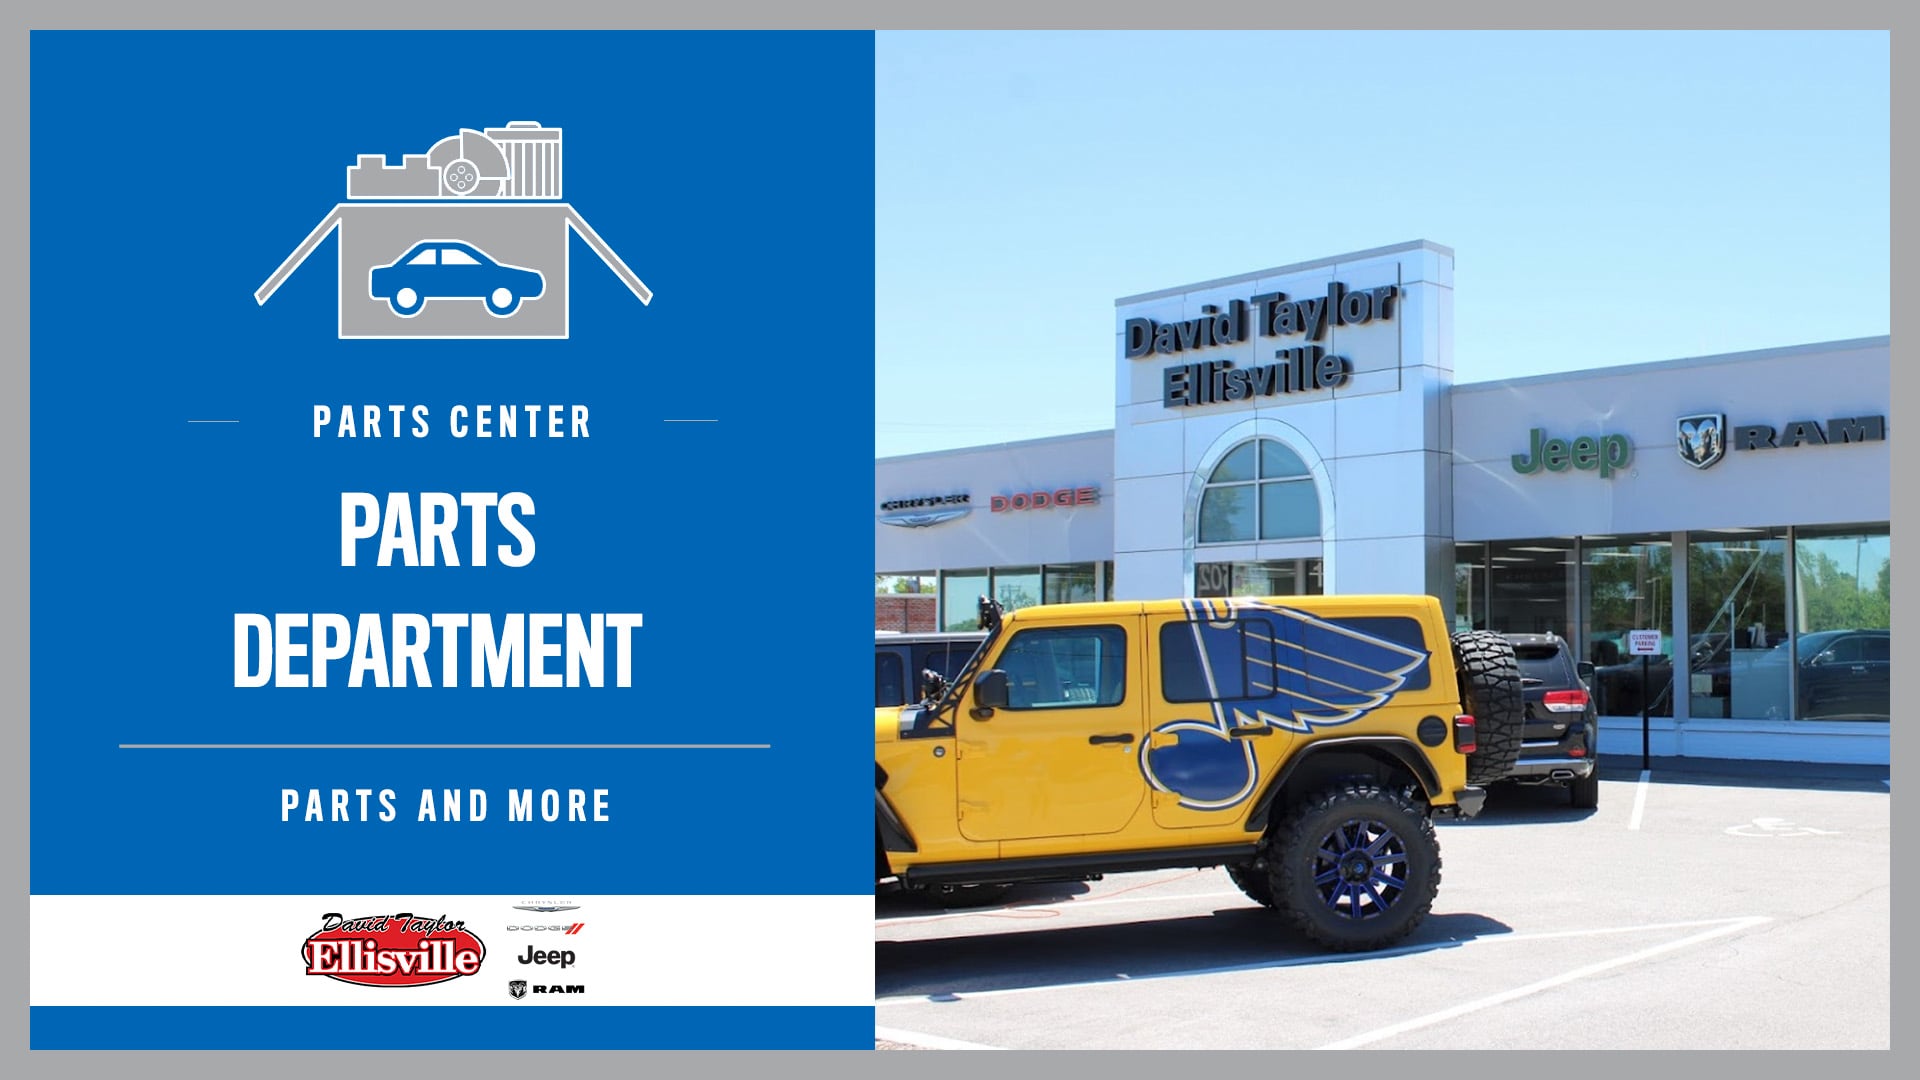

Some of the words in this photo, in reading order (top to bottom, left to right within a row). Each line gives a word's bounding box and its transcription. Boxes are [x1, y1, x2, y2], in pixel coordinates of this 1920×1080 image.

[1125, 299, 1245, 359] David
[1250, 281, 1396, 341] Taylor
[1163, 345, 1350, 408] Ellisville
[1511, 427, 1630, 479] Jeep
[1734, 415, 1885, 451] RAM
[990, 486, 1096, 513] DODGE
